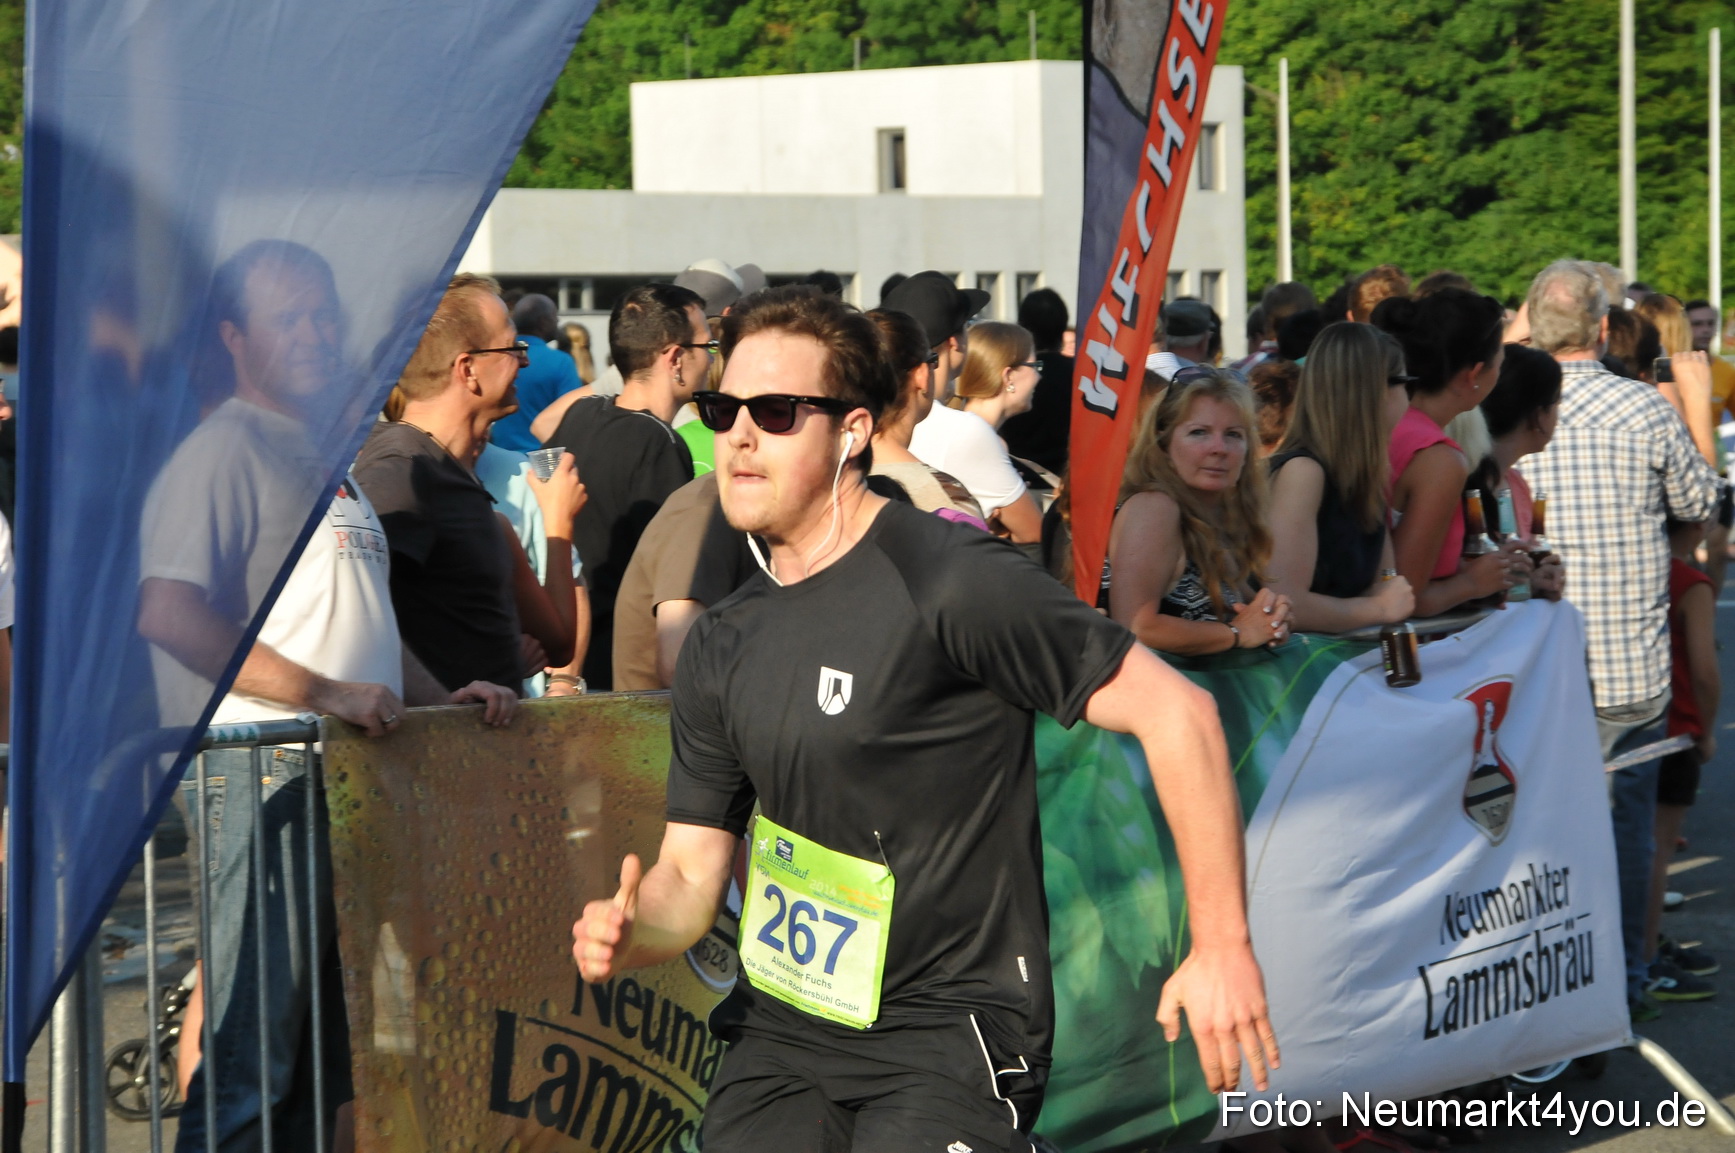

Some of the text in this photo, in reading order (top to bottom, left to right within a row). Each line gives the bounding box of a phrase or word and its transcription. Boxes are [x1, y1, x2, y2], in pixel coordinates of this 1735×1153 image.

[766, 849, 809, 880] firmenlauf
[757, 884, 858, 976] 267
[1440, 863, 1570, 945] Neumarkter
[745, 957, 757, 968] Die
[757, 964, 775, 978] Jäger
[776, 975, 787, 984] von
[788, 979, 833, 1004] Röckersbühl
[834, 998, 860, 1013] GmbH
[771, 956, 804, 979] Alexander
[805, 973, 832, 990] Fuchs
[1418, 919, 1595, 1040] Lammsbräu
